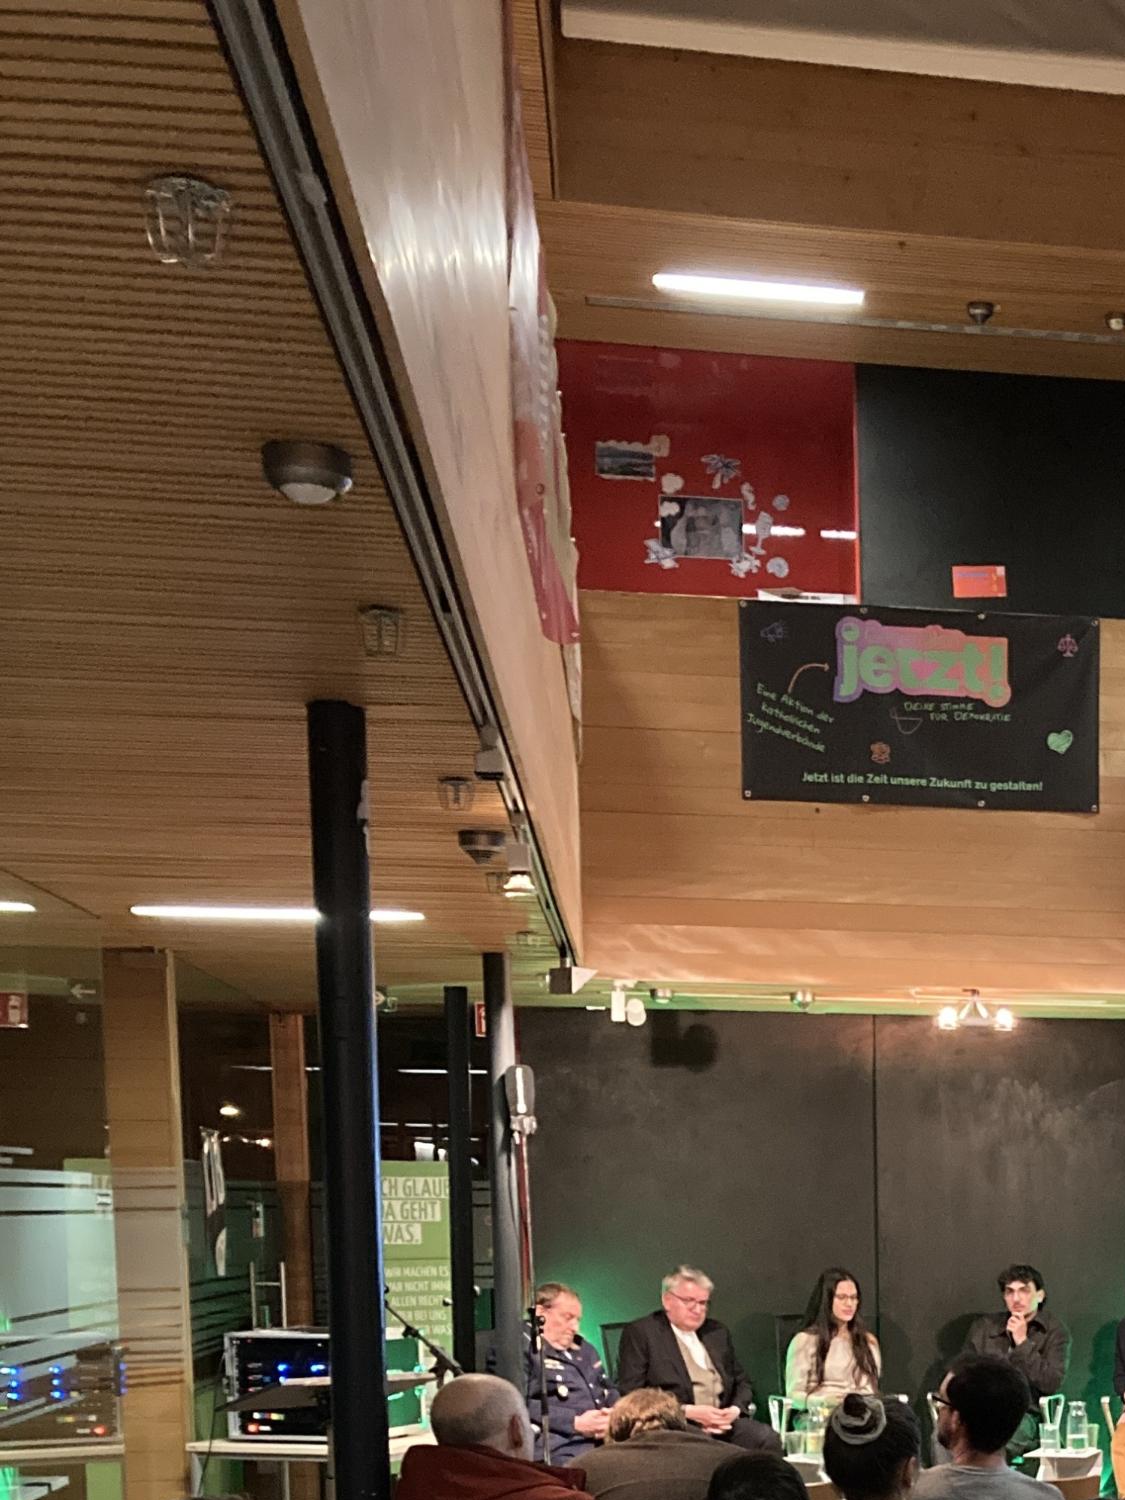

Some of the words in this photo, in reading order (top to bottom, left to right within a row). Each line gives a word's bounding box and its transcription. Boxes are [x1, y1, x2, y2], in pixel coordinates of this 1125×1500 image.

[839, 623, 1005, 699] jetzt!
[803, 771, 828, 783] Jetzt
[830, 772, 845, 784] ist
[846, 773, 865, 784] die
[866, 773, 888, 785] Zeit
[890, 775, 928, 787] unsere
[929, 777, 972, 789] Zukunft
[974, 780, 988, 790] zu
[989, 781, 1043, 793] gestalten!
[400, 1201, 437, 1220] GEHT
